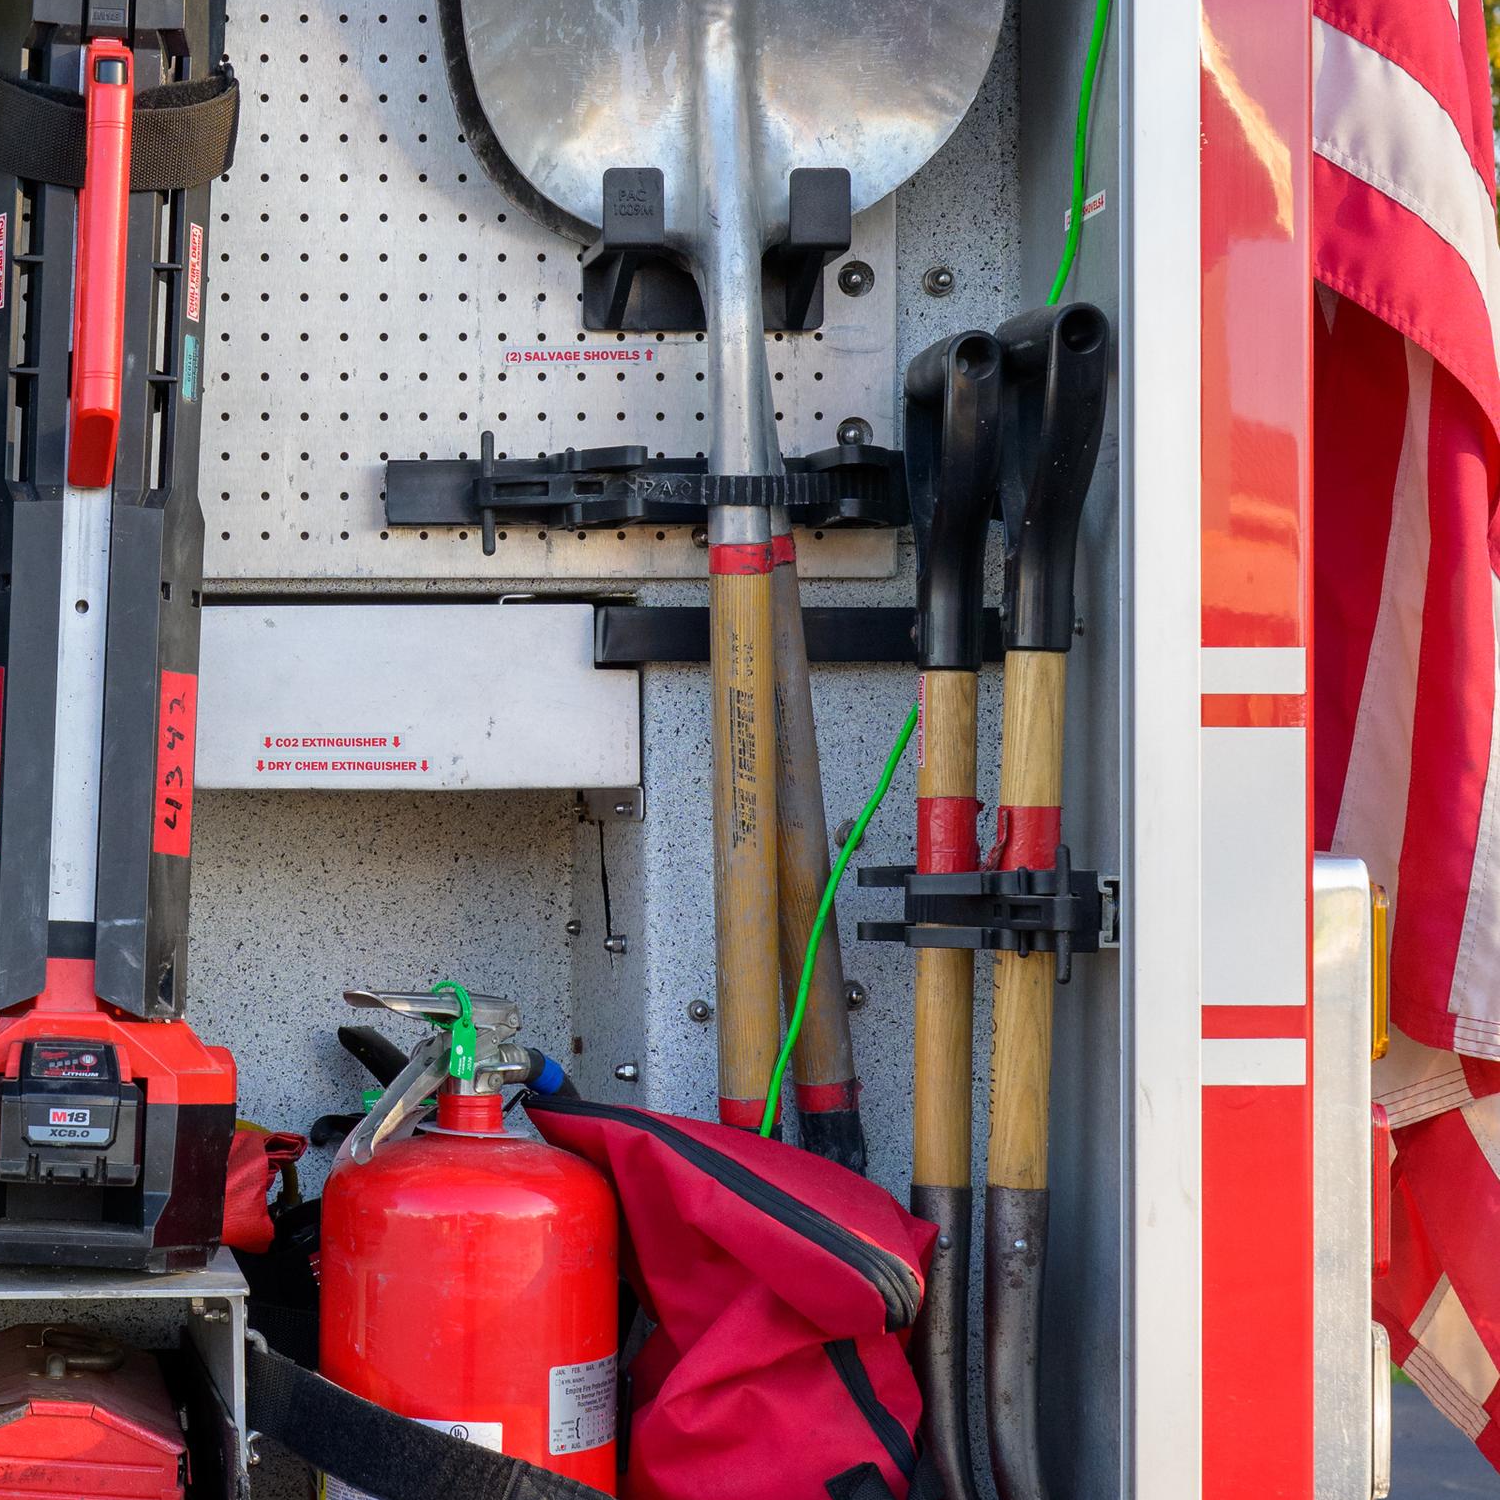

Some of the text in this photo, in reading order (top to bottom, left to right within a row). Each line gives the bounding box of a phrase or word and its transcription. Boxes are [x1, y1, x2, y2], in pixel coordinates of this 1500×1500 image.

[620, 190, 647, 202] PAC
[505, 351, 640, 363] (2) SALVAGE SHOVELS
[276, 738, 387, 748] CO2 EXTINGUISHER
[268, 761, 417, 771] DRY CHEM EXTINGUISHER
[52, 1112, 87, 1122] M18
[49, 1128, 90, 1138] XC8.0
